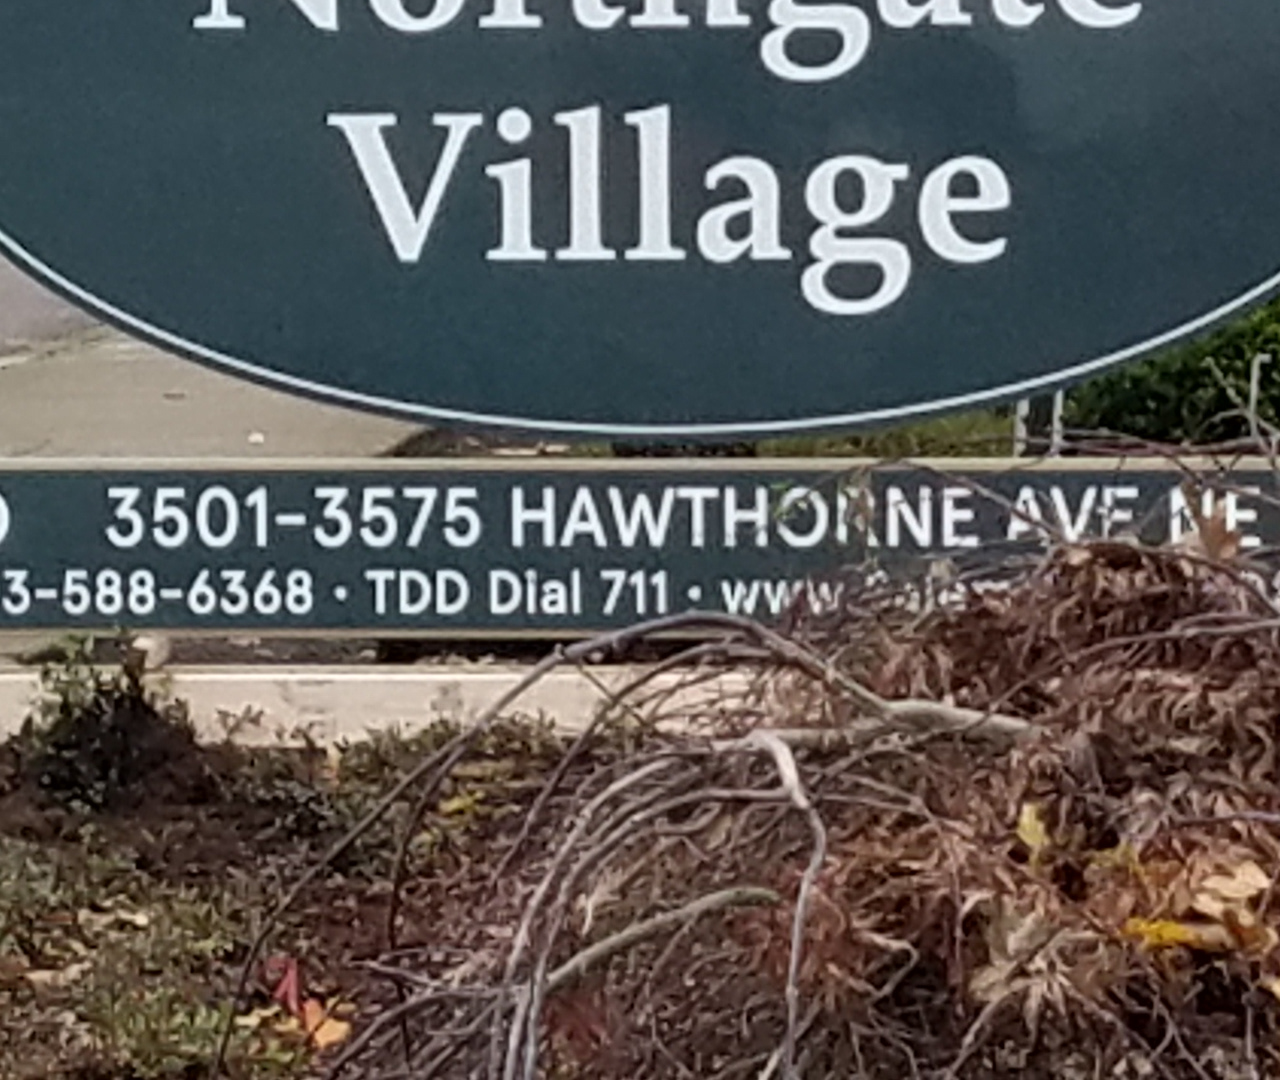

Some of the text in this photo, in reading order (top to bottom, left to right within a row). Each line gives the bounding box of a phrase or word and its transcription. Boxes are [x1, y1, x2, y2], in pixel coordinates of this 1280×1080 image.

[327, 104, 1011, 315] Village
[105, 486, 482, 548] 3501-3575
[1006, 486, 1140, 547] AVE
[1169, 486, 1262, 548] NE
[365, 569, 469, 615] TDD
[490, 569, 582, 615] Dial
[600, 569, 668, 615] 711
